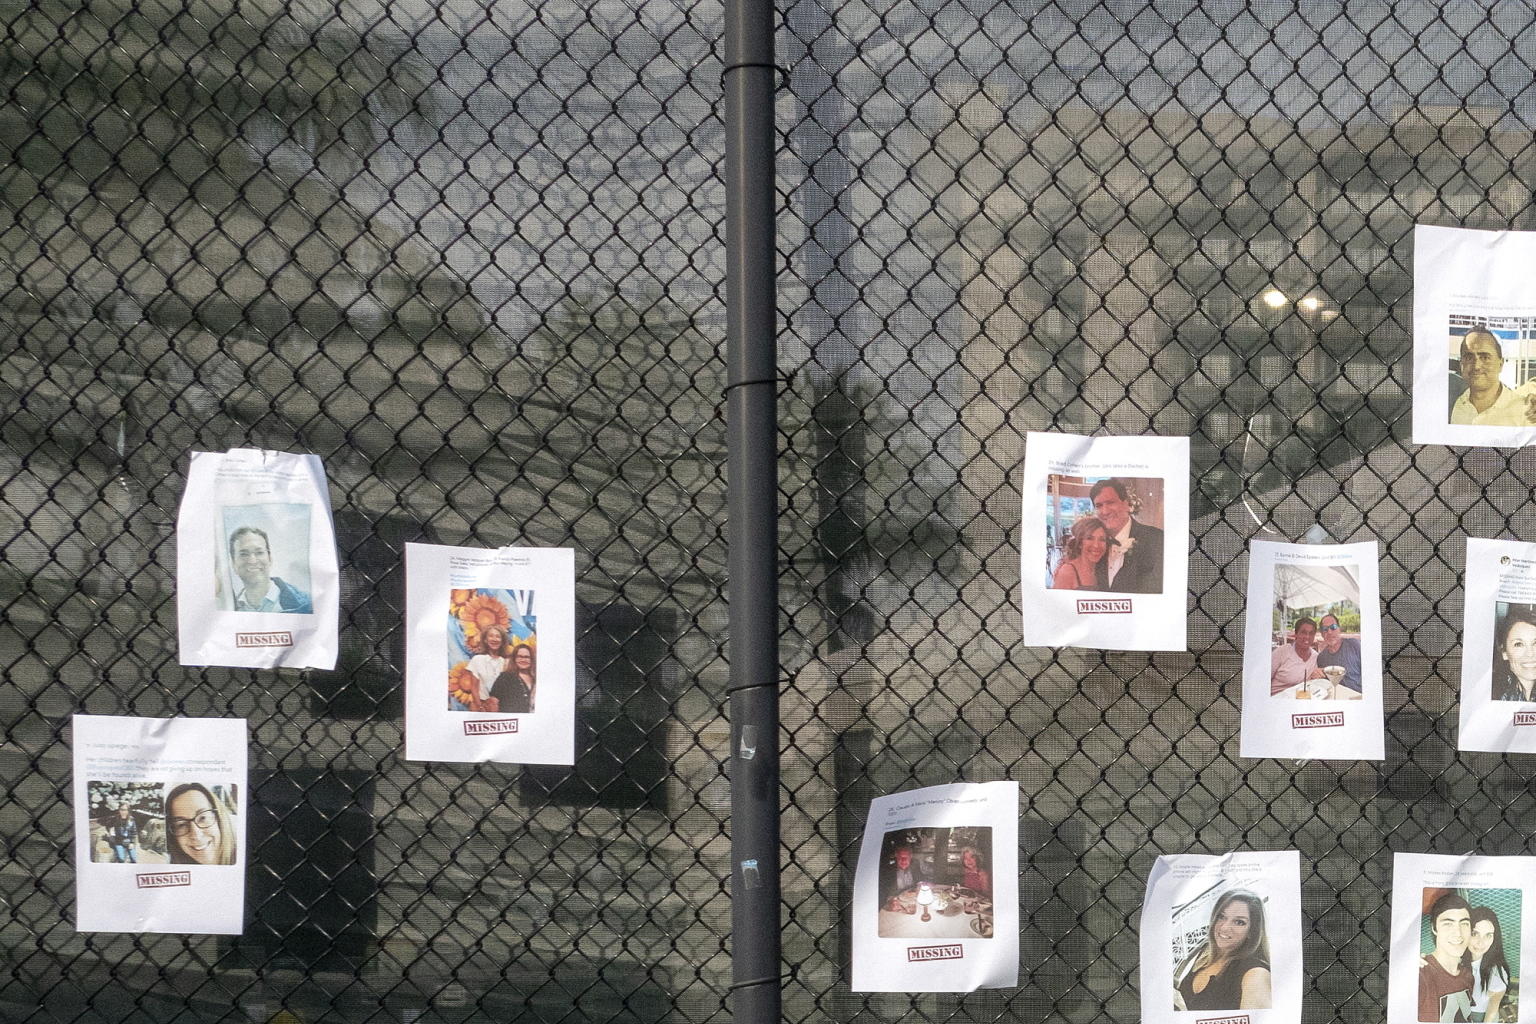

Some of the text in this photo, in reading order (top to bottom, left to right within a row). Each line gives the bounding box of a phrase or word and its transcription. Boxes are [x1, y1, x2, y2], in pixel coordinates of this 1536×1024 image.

[1080, 601, 1130, 612] MISSING
[238, 633, 290, 646] MISSING
[465, 719, 517, 733] MISSING
[1295, 714, 1342, 726] MISSING
[138, 872, 189, 887] MISSING
[911, 948, 961, 960] MISSING
